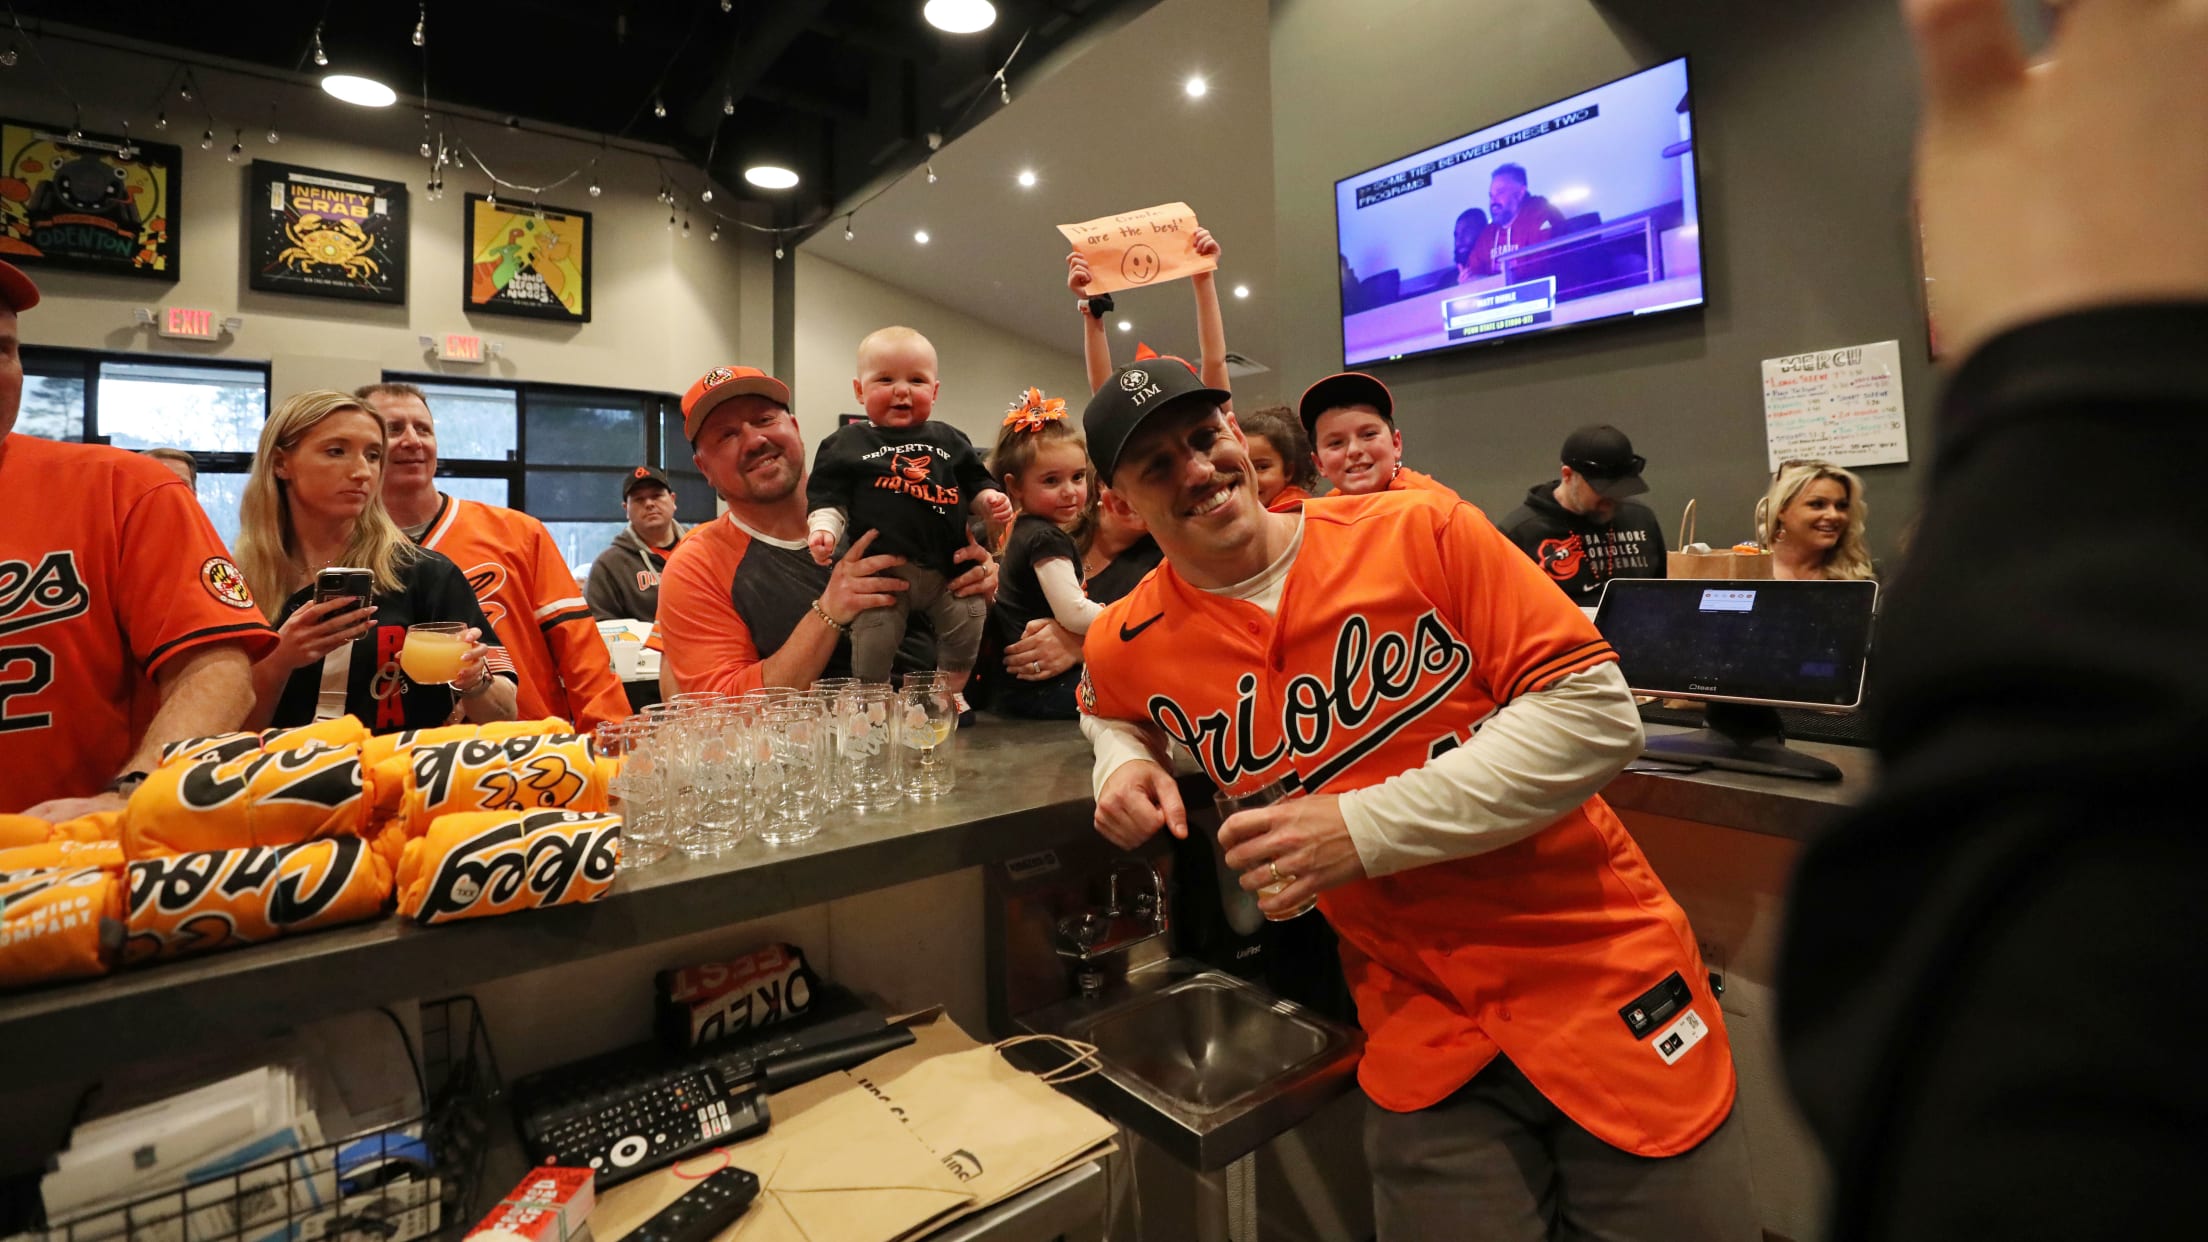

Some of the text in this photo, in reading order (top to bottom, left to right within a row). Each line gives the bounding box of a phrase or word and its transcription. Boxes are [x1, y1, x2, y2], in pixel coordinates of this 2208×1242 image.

[1373, 172, 1407, 191] SOME
[1409, 162, 1436, 178] TIES
[1438, 139, 1501, 169] BETWEEN
[1503, 122, 1550, 147] THESE
[1553, 110, 1590, 130] TWO
[290, 184, 370, 206] INFINITY
[1358, 178, 1425, 208] PROGRAMS
[292, 196, 369, 219] CRAB
[36, 225, 133, 257] ODENTON
[1088, 232, 1110, 245] are
[1119, 225, 1143, 238] the
[168, 306, 213, 337] EXIT
[446, 335, 481, 361] EXIT
[1780, 348, 1862, 373] MERCH
[1131, 383, 1163, 407] IJM
[862, 443, 934, 461] PROPERTY
[1584, 530, 1647, 546] BATIMORE
[1588, 543, 1640, 559] ORIOLES
[1590, 556, 1649, 571] BEBALL
[1147, 607, 1472, 790] Orioles
